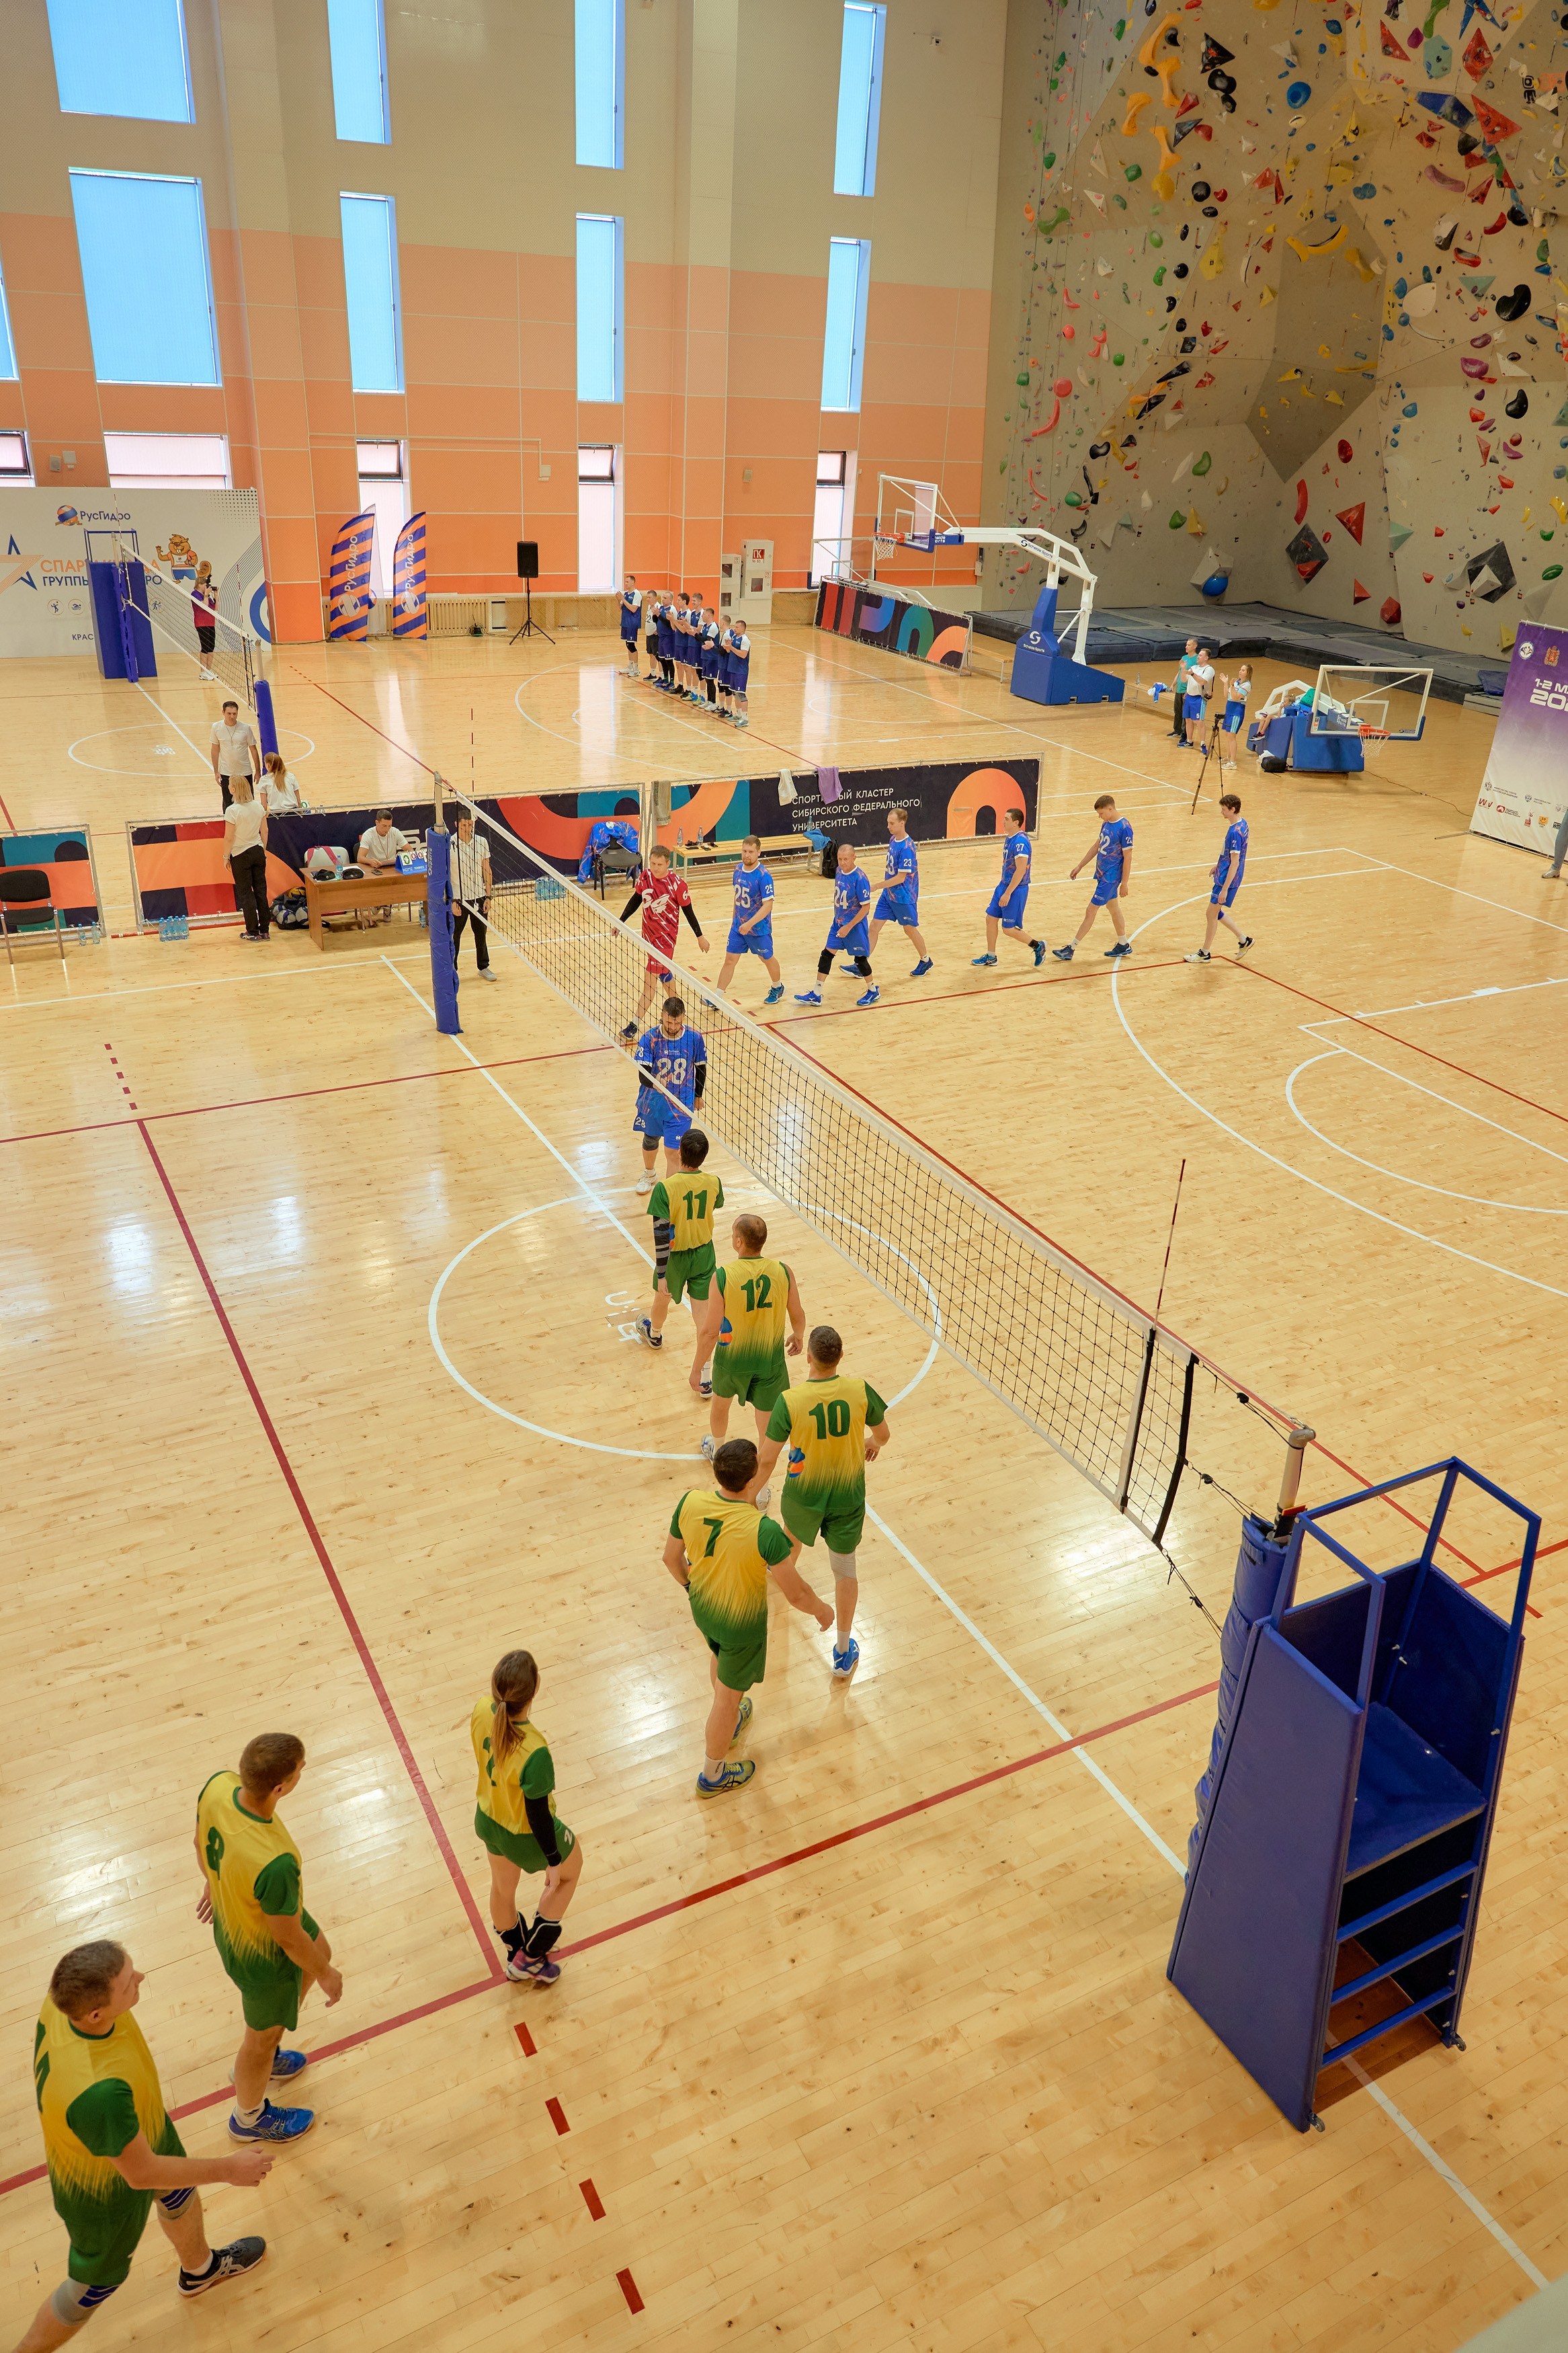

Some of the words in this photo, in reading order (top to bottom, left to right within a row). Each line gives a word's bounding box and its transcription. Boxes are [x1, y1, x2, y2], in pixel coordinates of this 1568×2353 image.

[344, 536, 358, 592] РусГидро
[405, 534, 415, 590] РусГидро
[753, 549, 762, 559] ПК
[1534, 678, 1553, 690] 1-2
[1555, 683, 1568, 694] М
[792, 789, 852, 805] СПОРТЫЙ
[856, 788, 895, 799] КЛАСТЕР
[792, 805, 850, 818] СИБИРСКОГО
[853, 799, 920, 812] ФЕДЕРАЛЬНОГО
[1016, 843, 1024, 852] 27
[903, 859, 912, 867] 23
[735, 884, 751, 908] 25
[765, 884, 773, 894] 25
[834, 886, 849, 910] 24
[656, 1058, 687, 1085] 28
[635, 1117, 646, 1128] 28
[683, 1189, 707, 1220] 11
[741, 1274, 772, 1312] 12
[809, 1399, 850, 1439] 10
[703, 1517, 723, 1558] 7
